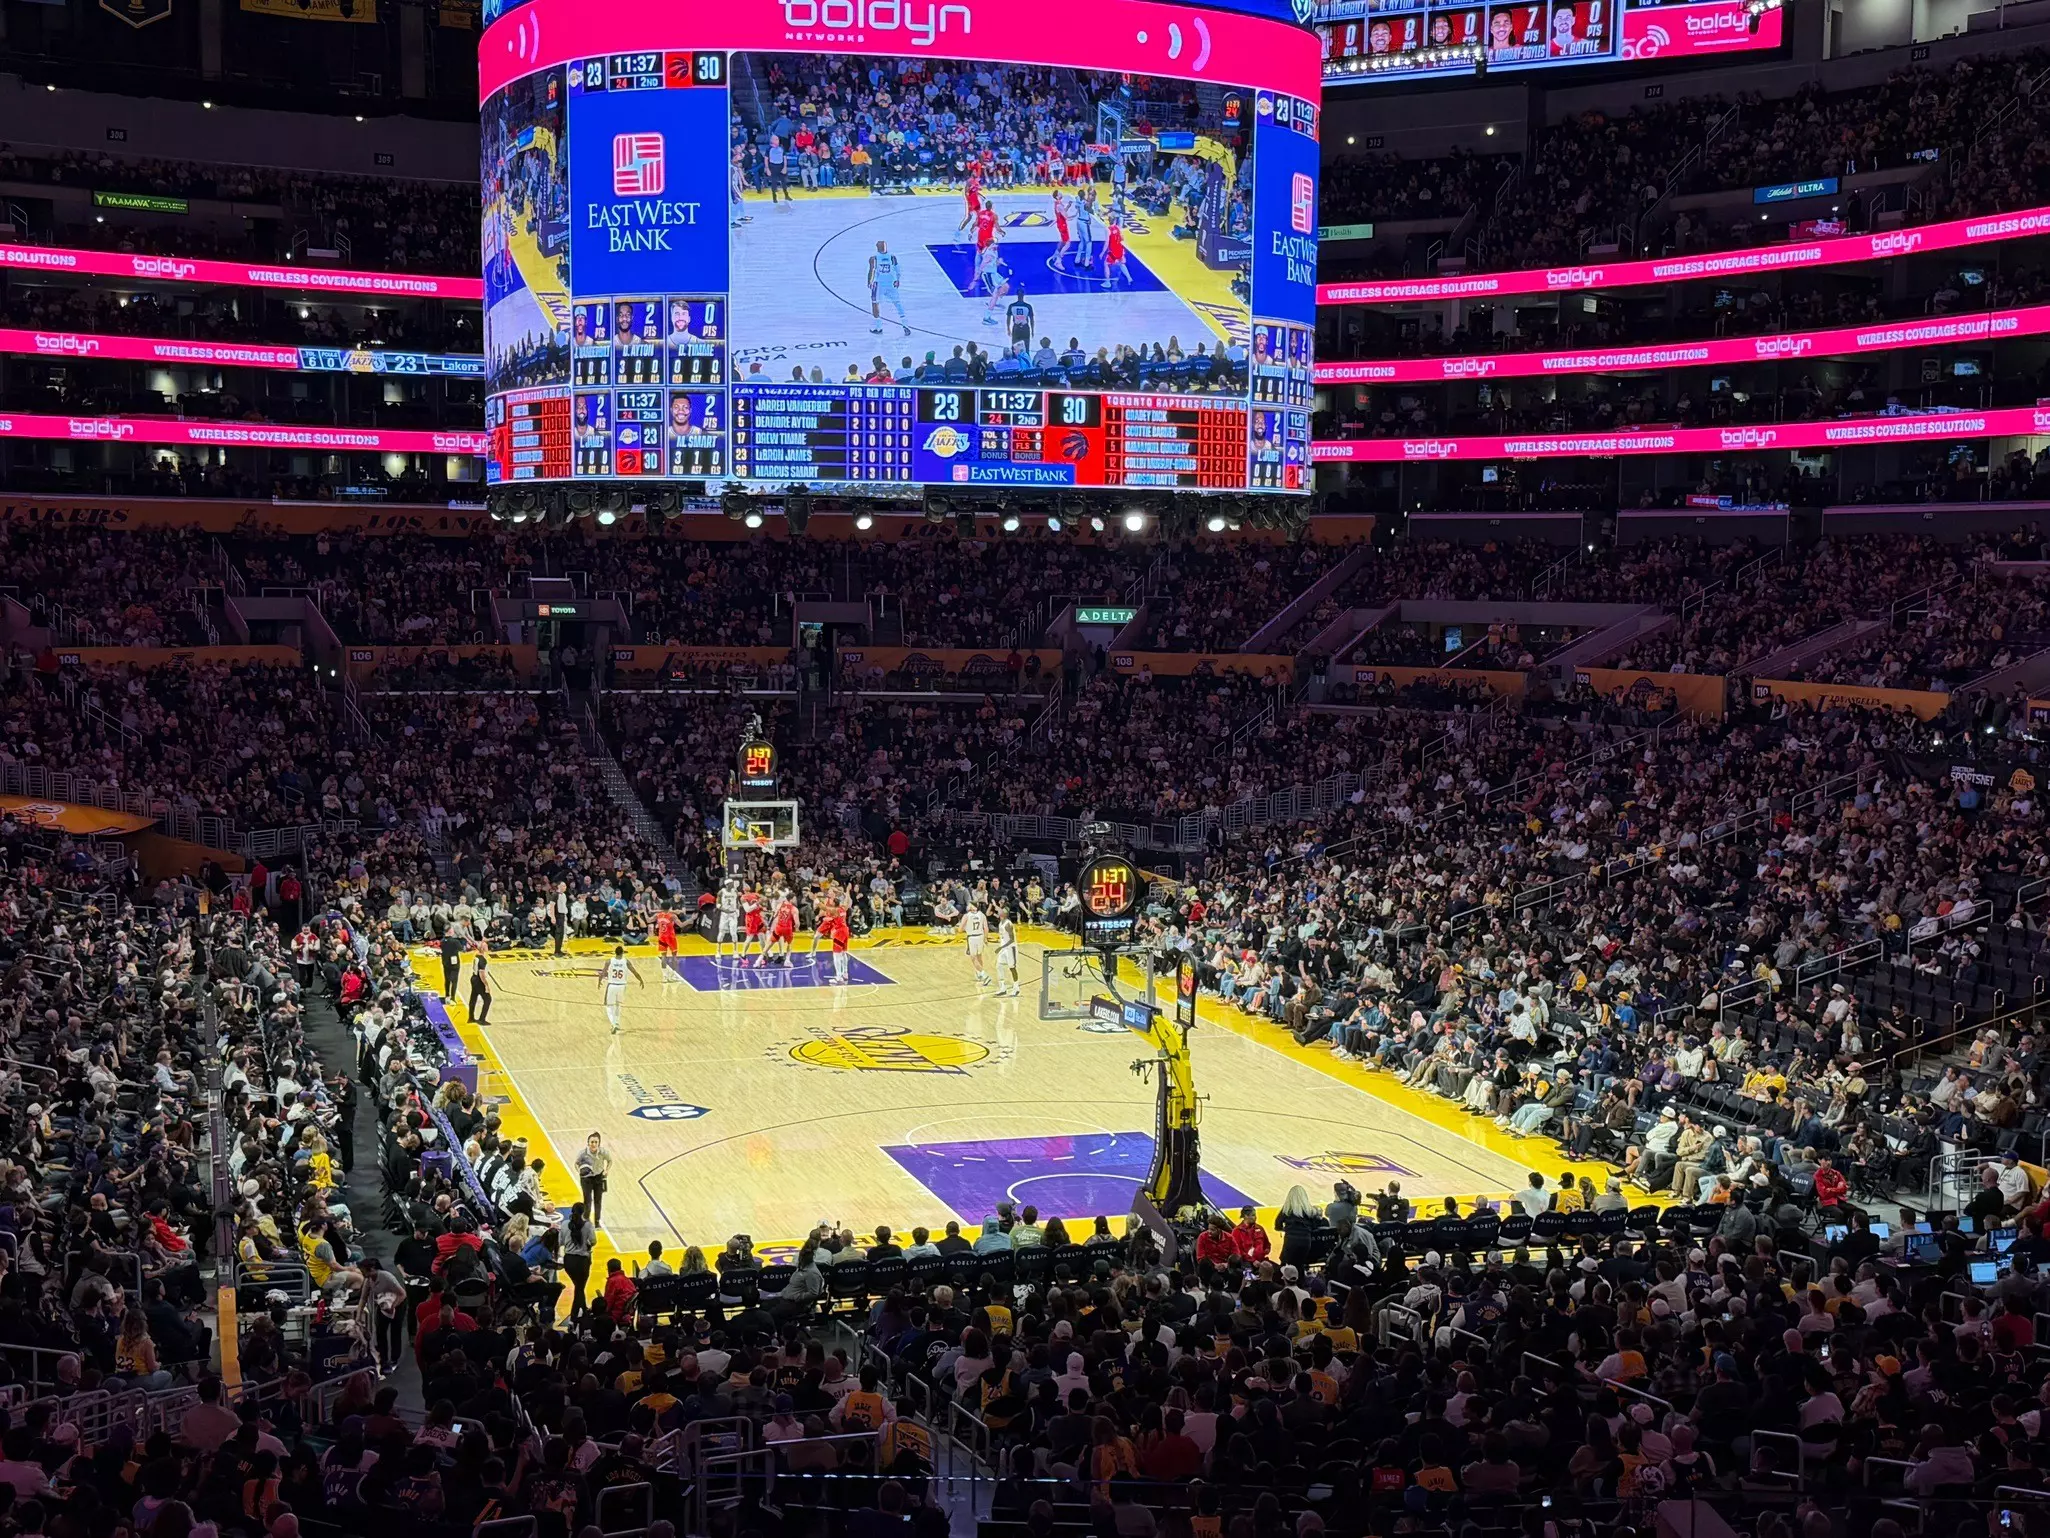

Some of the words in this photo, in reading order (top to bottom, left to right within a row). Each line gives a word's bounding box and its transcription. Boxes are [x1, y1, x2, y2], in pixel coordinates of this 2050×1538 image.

[1528, 8, 1538, 29] 7
[1590, 1, 1600, 23] 0
[782, 0, 972, 46] boldyn
[1405, 19, 1415, 40] 8
[1465, 13, 1475, 35] 0
[1587, 24, 1603, 37] PTS
[1346, 25, 1356, 45] 0
[1569, 40, 1599, 54] BATTLE
[615, 55, 656, 73] 11:37
[698, 57, 719, 80] 30
[586, 62, 602, 86] 23
[640, 77, 658, 87] 2ND
[616, 78, 628, 89] 24
[1277, 100, 1288, 121] 23
[1798, 183, 1824, 193] ULTRA
[1966, 220, 2019, 239] WIRELESS
[609, 227, 672, 252] BANK
[1872, 232, 1921, 254] boldyn
[7, 249, 76, 267] SOLUTIONS
[1653, 262, 1704, 277] WIRELESS
[1705, 254, 1760, 271] COVERAGE
[1761, 248, 1821, 265] SOLUTIONS
[132, 256, 195, 279] boldyn
[1287, 258, 1313, 287] BANK
[248, 270, 309, 284] WIRELESS
[311, 274, 371, 288] COVERAGE
[373, 277, 437, 292] SOLUTIONS
[1546, 269, 1603, 286] boldyn
[1327, 288, 1381, 299] WIRELESS
[1384, 284, 1440, 297] COVERAGE
[1441, 279, 1498, 294] SOLUTIONS
[645, 305, 655, 323] 2
[705, 304, 714, 324] 0
[703, 325, 716, 337] PTS
[1858, 331, 1904, 346] WIRELESS
[1905, 324, 1957, 341] COVERAGE
[1958, 317, 2018, 335] SOLUTIONS
[35, 333, 99, 356] boldyn
[1755, 337, 1811, 359] boldyn
[154, 345, 213, 359] WIRELESS
[215, 349, 274, 364] COVERAGE
[1542, 356, 1596, 369] WIRELESS
[1597, 352, 1651, 366] COVERAGE
[1653, 348, 1708, 363] SOLUTIONS
[394, 356, 417, 371] 23
[441, 360, 478, 372] Lakers
[1443, 359, 1495, 379] boldyn
[1336, 366, 1395, 378] SOLUTIONS
[622, 393, 656, 407] 11:37
[849, 388, 862, 398] PTS
[882, 389, 895, 398] AST
[988, 393, 1036, 409] 11:37
[706, 396, 715, 415] 2
[738, 400, 744, 411] 2
[934, 394, 959, 420] 23
[1064, 398, 1085, 424] 30
[738, 416, 744, 427] 5
[989, 414, 1002, 424] 24
[1018, 416, 1037, 426] 2ND
[69, 418, 133, 440] boldyn
[189, 427, 248, 440] WIRELESS
[250, 431, 311, 445] COVERAGE
[313, 433, 379, 446] SOLUTIONS
[644, 429, 657, 444] 23
[982, 431, 997, 439] TOL
[1826, 427, 1875, 440] WIRELESS
[1875, 423, 1927, 437] COVERAGE
[1928, 419, 1985, 434] SOLUTIONS
[737, 432, 746, 443] 17
[982, 441, 997, 449] FLS
[1504, 441, 1558, 453] WIRELESS
[1559, 438, 1616, 451] COVERAGE
[1617, 437, 1674, 449] SOLUTIONS
[1720, 428, 1776, 448] boldyn
[1016, 442, 1030, 450] FLS
[1404, 441, 1458, 459] boldyn
[644, 453, 657, 469] 30
[736, 449, 747, 460] 23
[981, 451, 1008, 460] BONUS
[736, 466, 747, 477] 36
[1035, 470, 1068, 482] BANK
[1092, 612, 1134, 621] DELTA
[352, 652, 371, 660] 106
[615, 651, 632, 660] 107
[844, 653, 861, 661] 107
[1116, 657, 1132, 666] 108
[1358, 672, 1373, 681] 108
[747, 758, 769, 774] 24
[1950, 770, 1995, 786] SPORTSNET
[1094, 869, 1127, 883] 11:37
[972, 921, 980, 930] 17
[1100, 920, 1132, 928] TISSOT
[612, 969, 624, 979] 36
